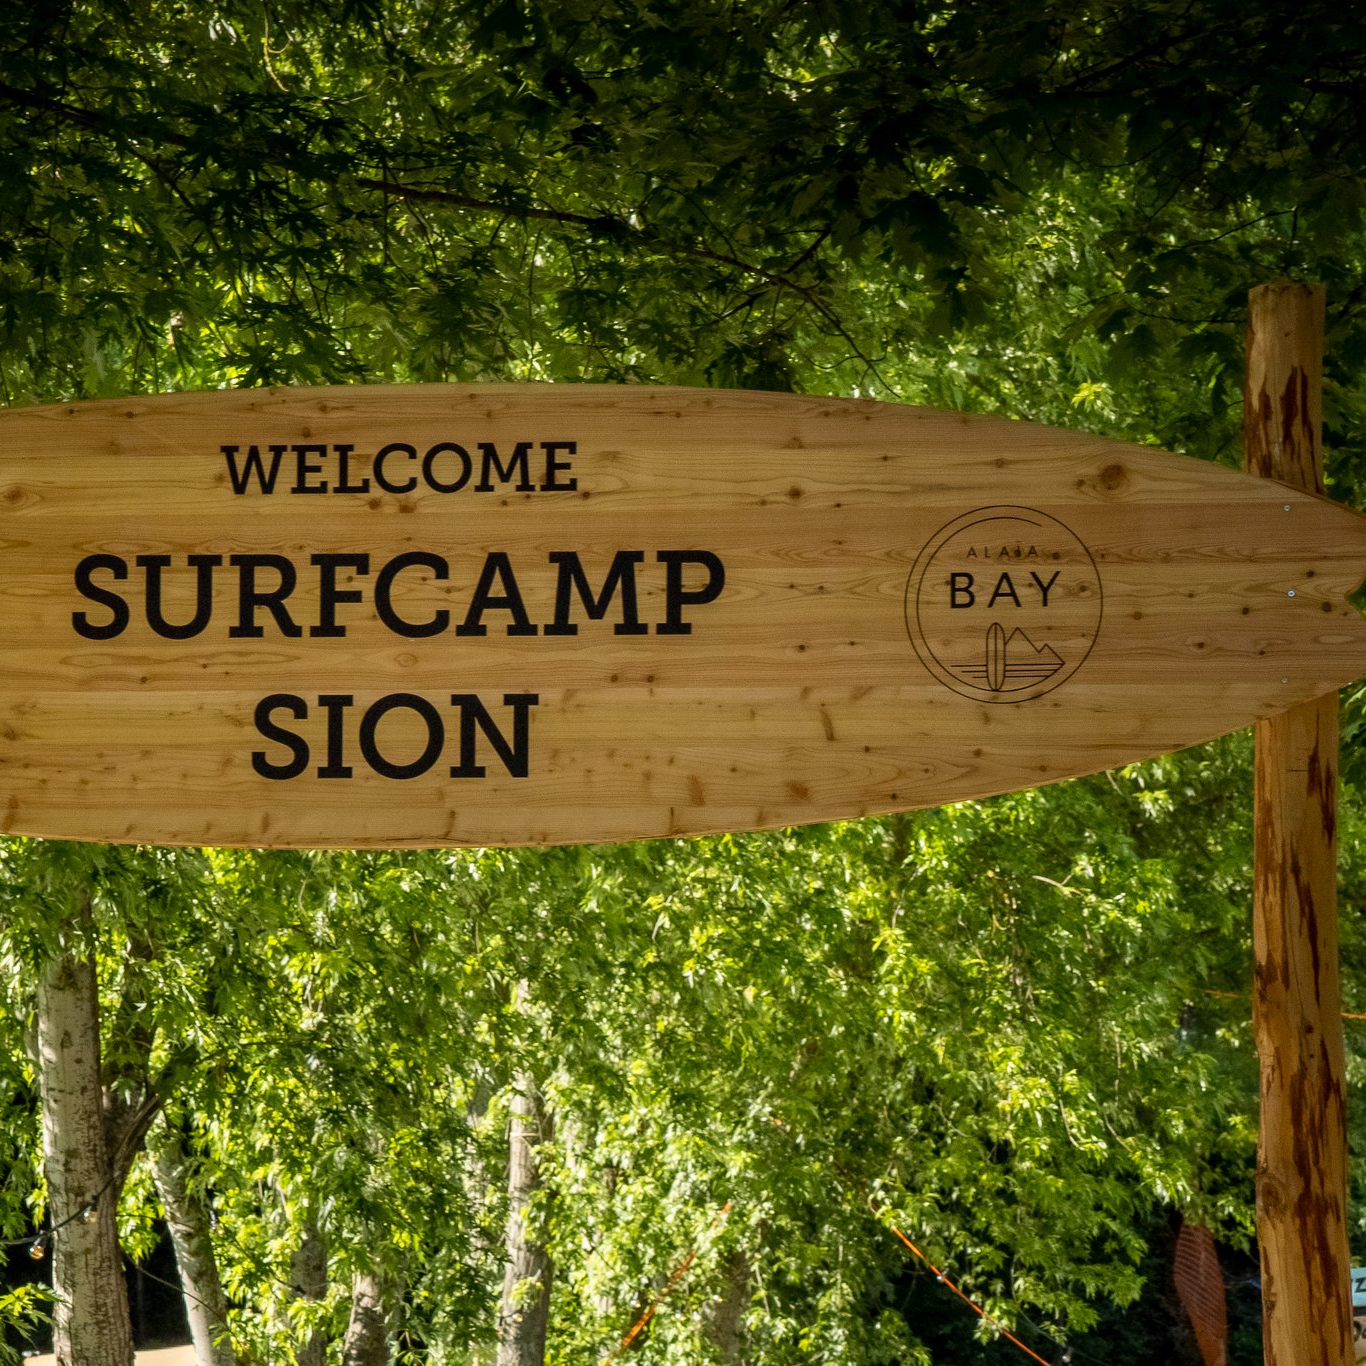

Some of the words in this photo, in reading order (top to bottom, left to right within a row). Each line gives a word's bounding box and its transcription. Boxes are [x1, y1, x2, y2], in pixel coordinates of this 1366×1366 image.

[220, 441, 578, 495] WELCOME
[71, 550, 726, 641] SURFCAMP
[949, 570, 1061, 609] BAY
[251, 692, 539, 781] SION
